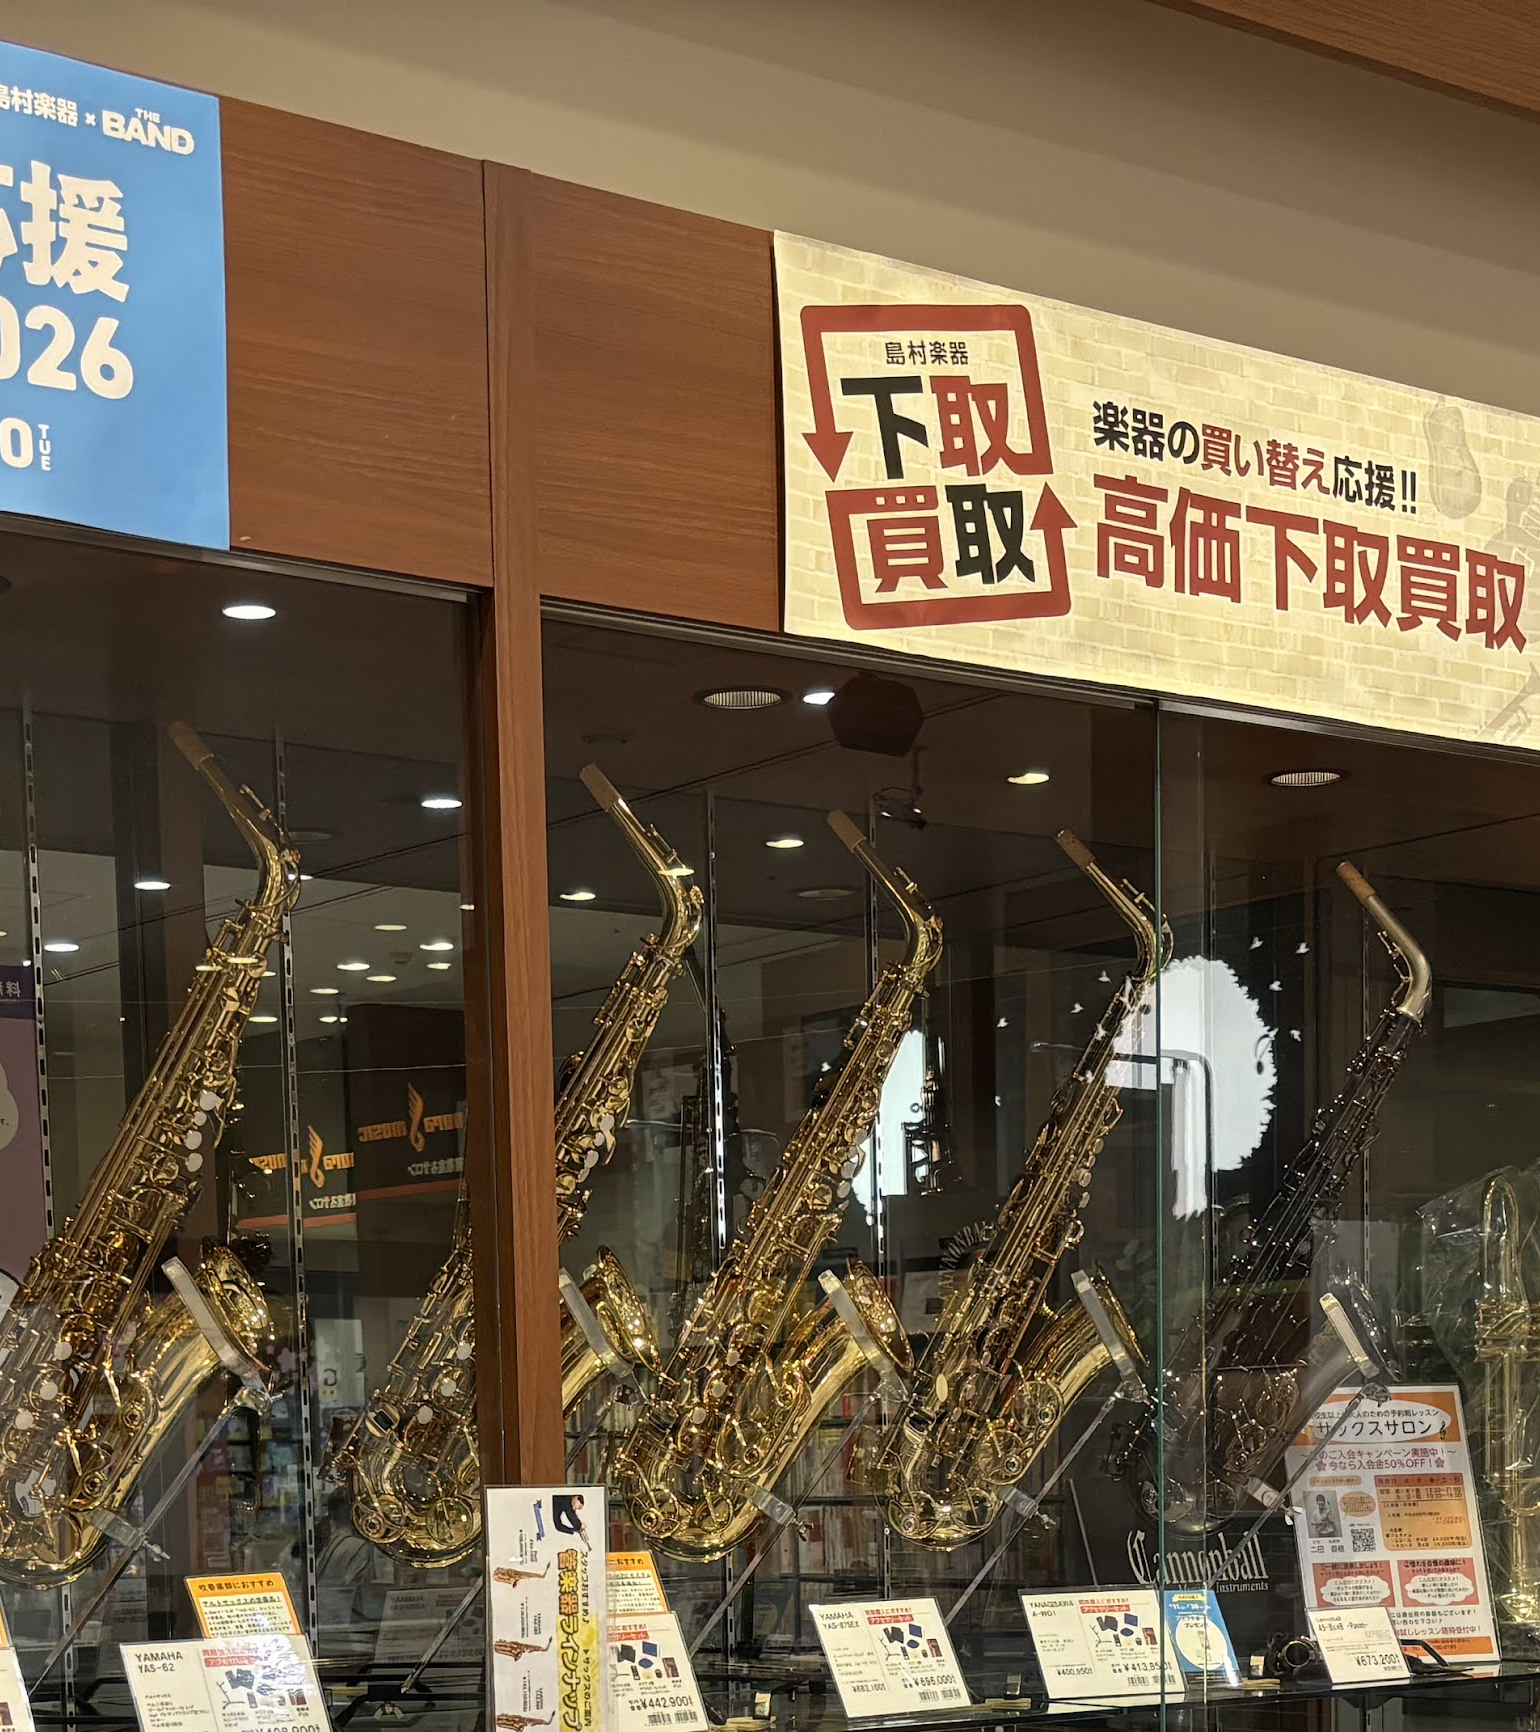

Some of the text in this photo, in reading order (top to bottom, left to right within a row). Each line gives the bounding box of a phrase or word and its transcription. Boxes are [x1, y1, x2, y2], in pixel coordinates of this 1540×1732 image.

[103, 109, 194, 155] BAND
[134, 108, 160, 123] THE
[885, 340, 970, 367] 島村楽器
[840, 375, 1017, 479] 下取
[38, 423, 52, 471] TUE
[1092, 400, 1418, 515] 楽器の買い替え応援!!
[865, 482, 1035, 593] 買取
[1092, 474, 1528, 654] 高価下取買取
[1317, 1420, 1432, 1437] サックスサロン
[1127, 1530, 1269, 1585] Cannonball
[198, 1580, 274, 1592] 吹奏楽部におすすめ
[1216, 1581, 1269, 1593] Instruments
[819, 1611, 854, 1620] YAMAHA
[134, 1651, 183, 1662] YAMAHA
[557, 1549, 583, 1732] 管楽器ラインナップ
[138, 1663, 175, 1674] YAS-62
